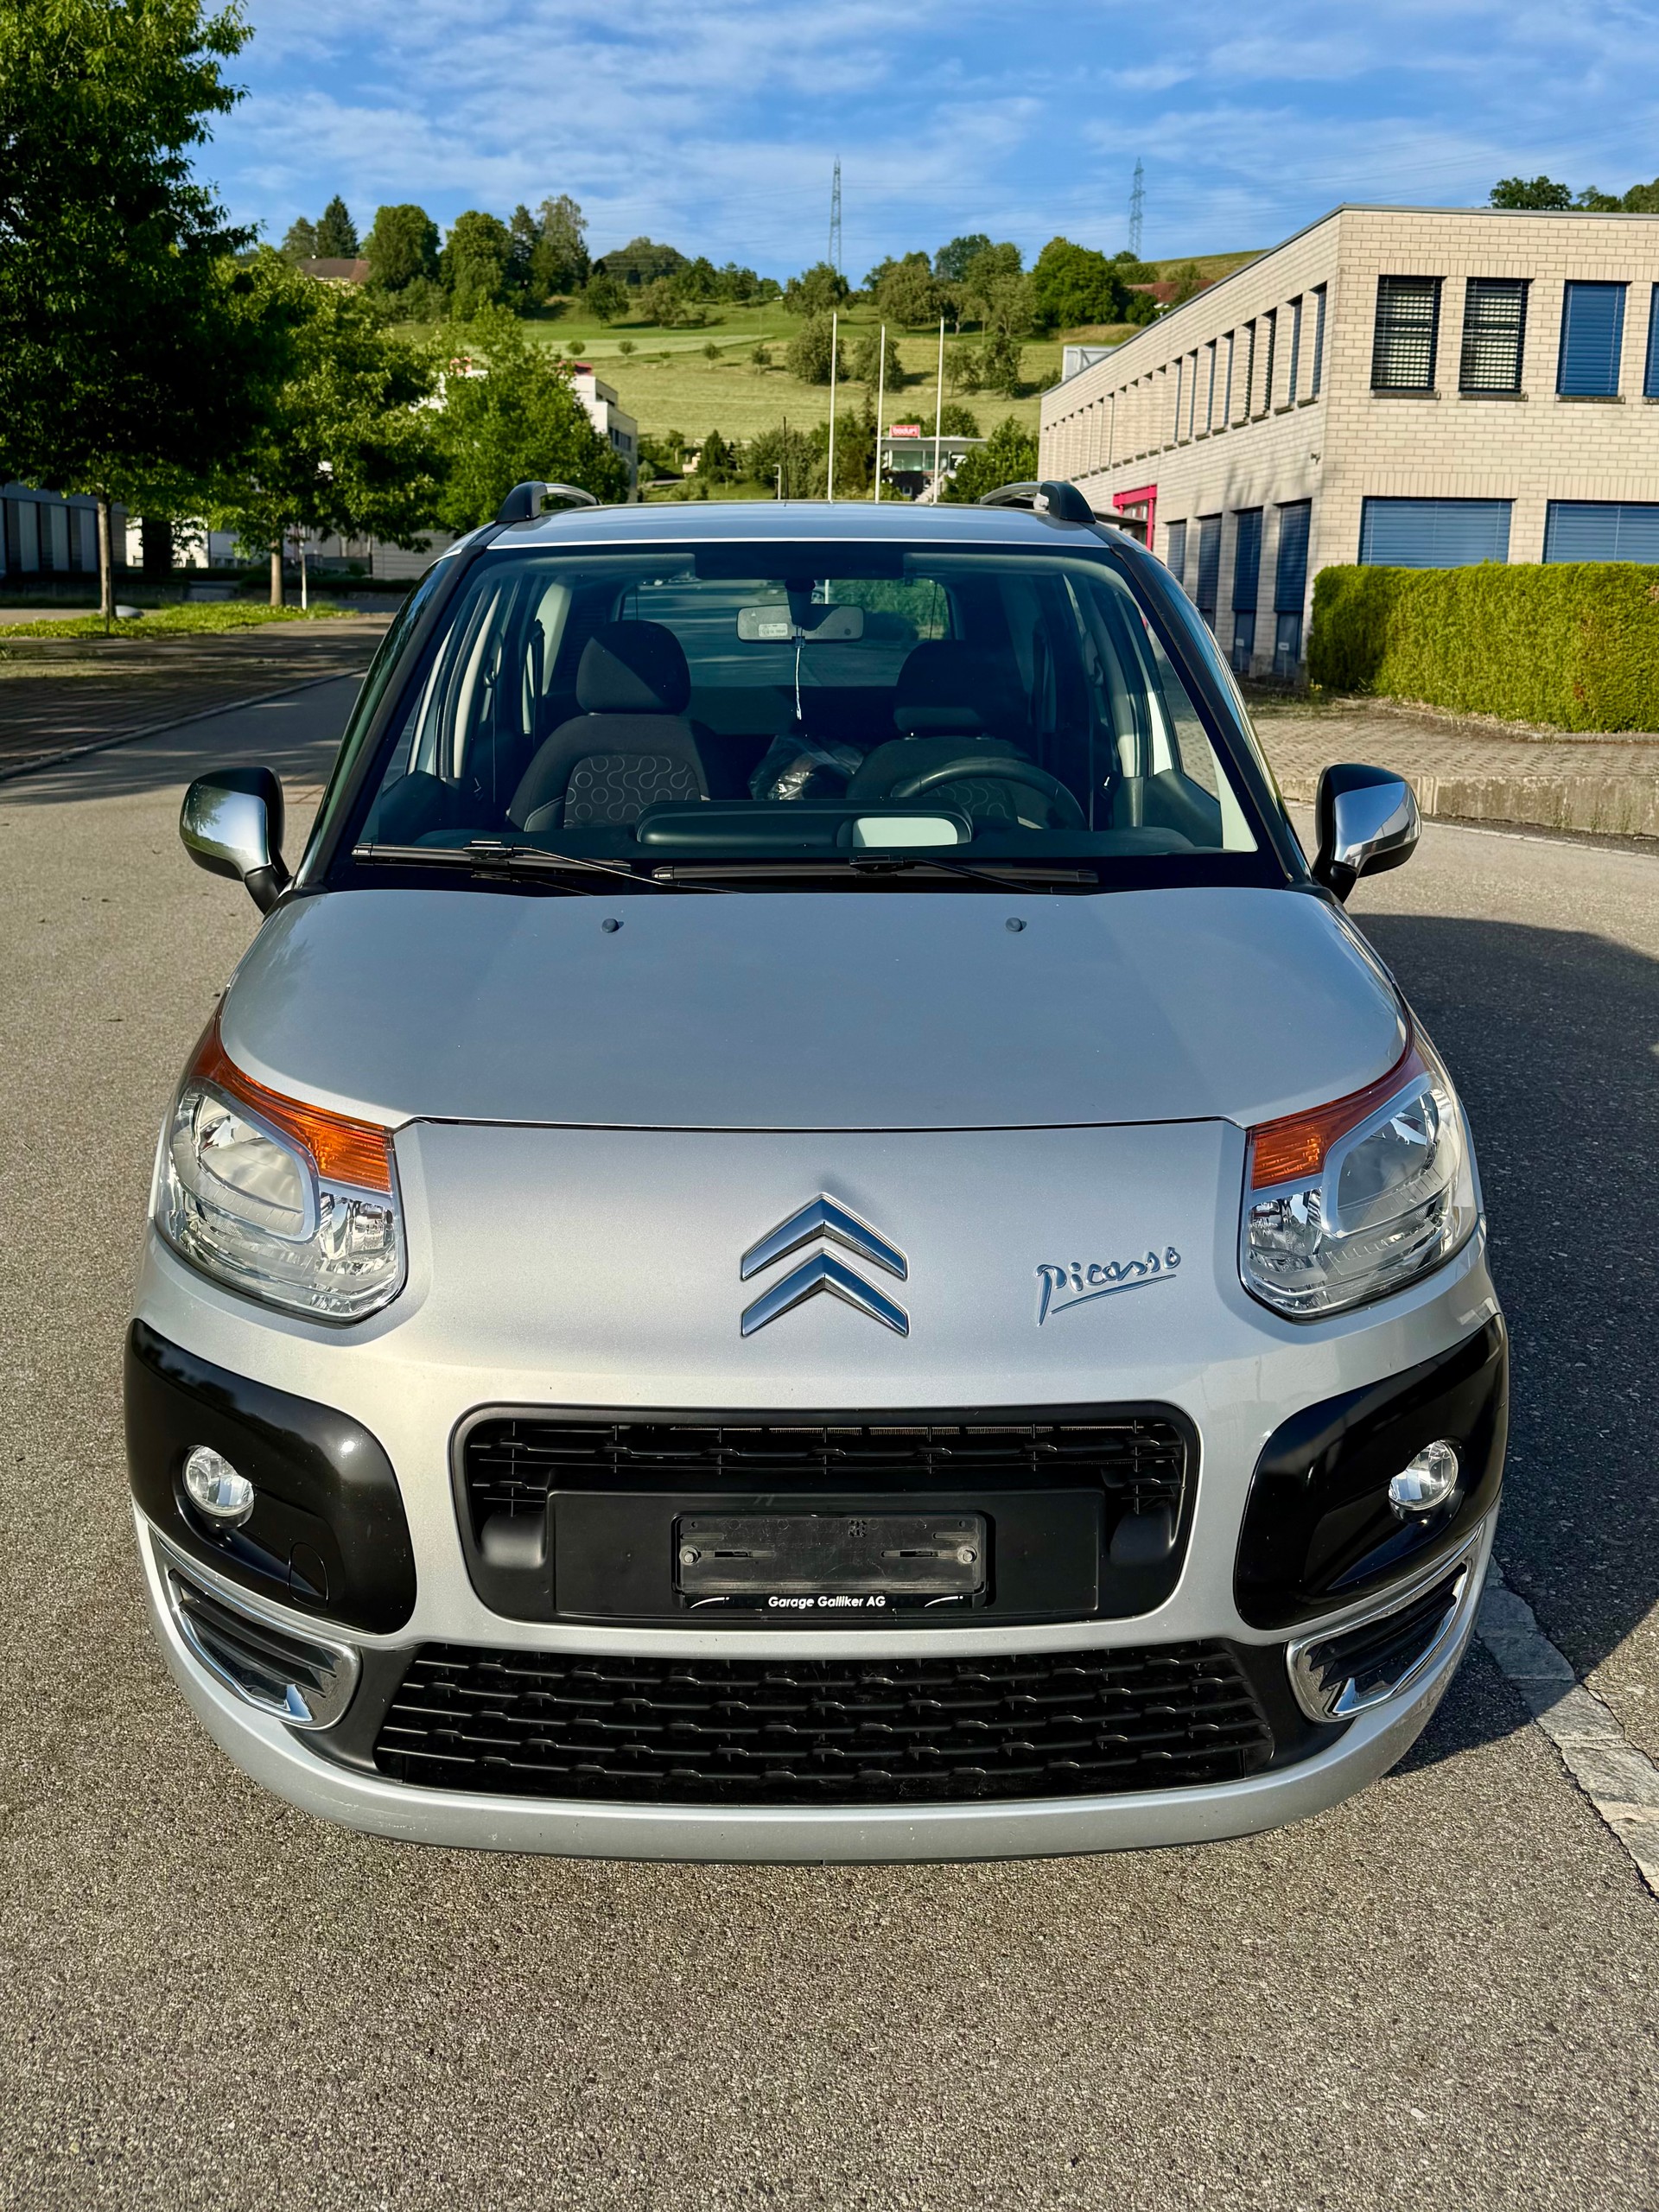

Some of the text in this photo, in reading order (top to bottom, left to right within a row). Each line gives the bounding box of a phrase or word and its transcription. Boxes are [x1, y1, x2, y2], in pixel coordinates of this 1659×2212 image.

[1035, 1246, 1182, 1326] Picasso
[767, 1595, 887, 1610] Garage Galliker AG
